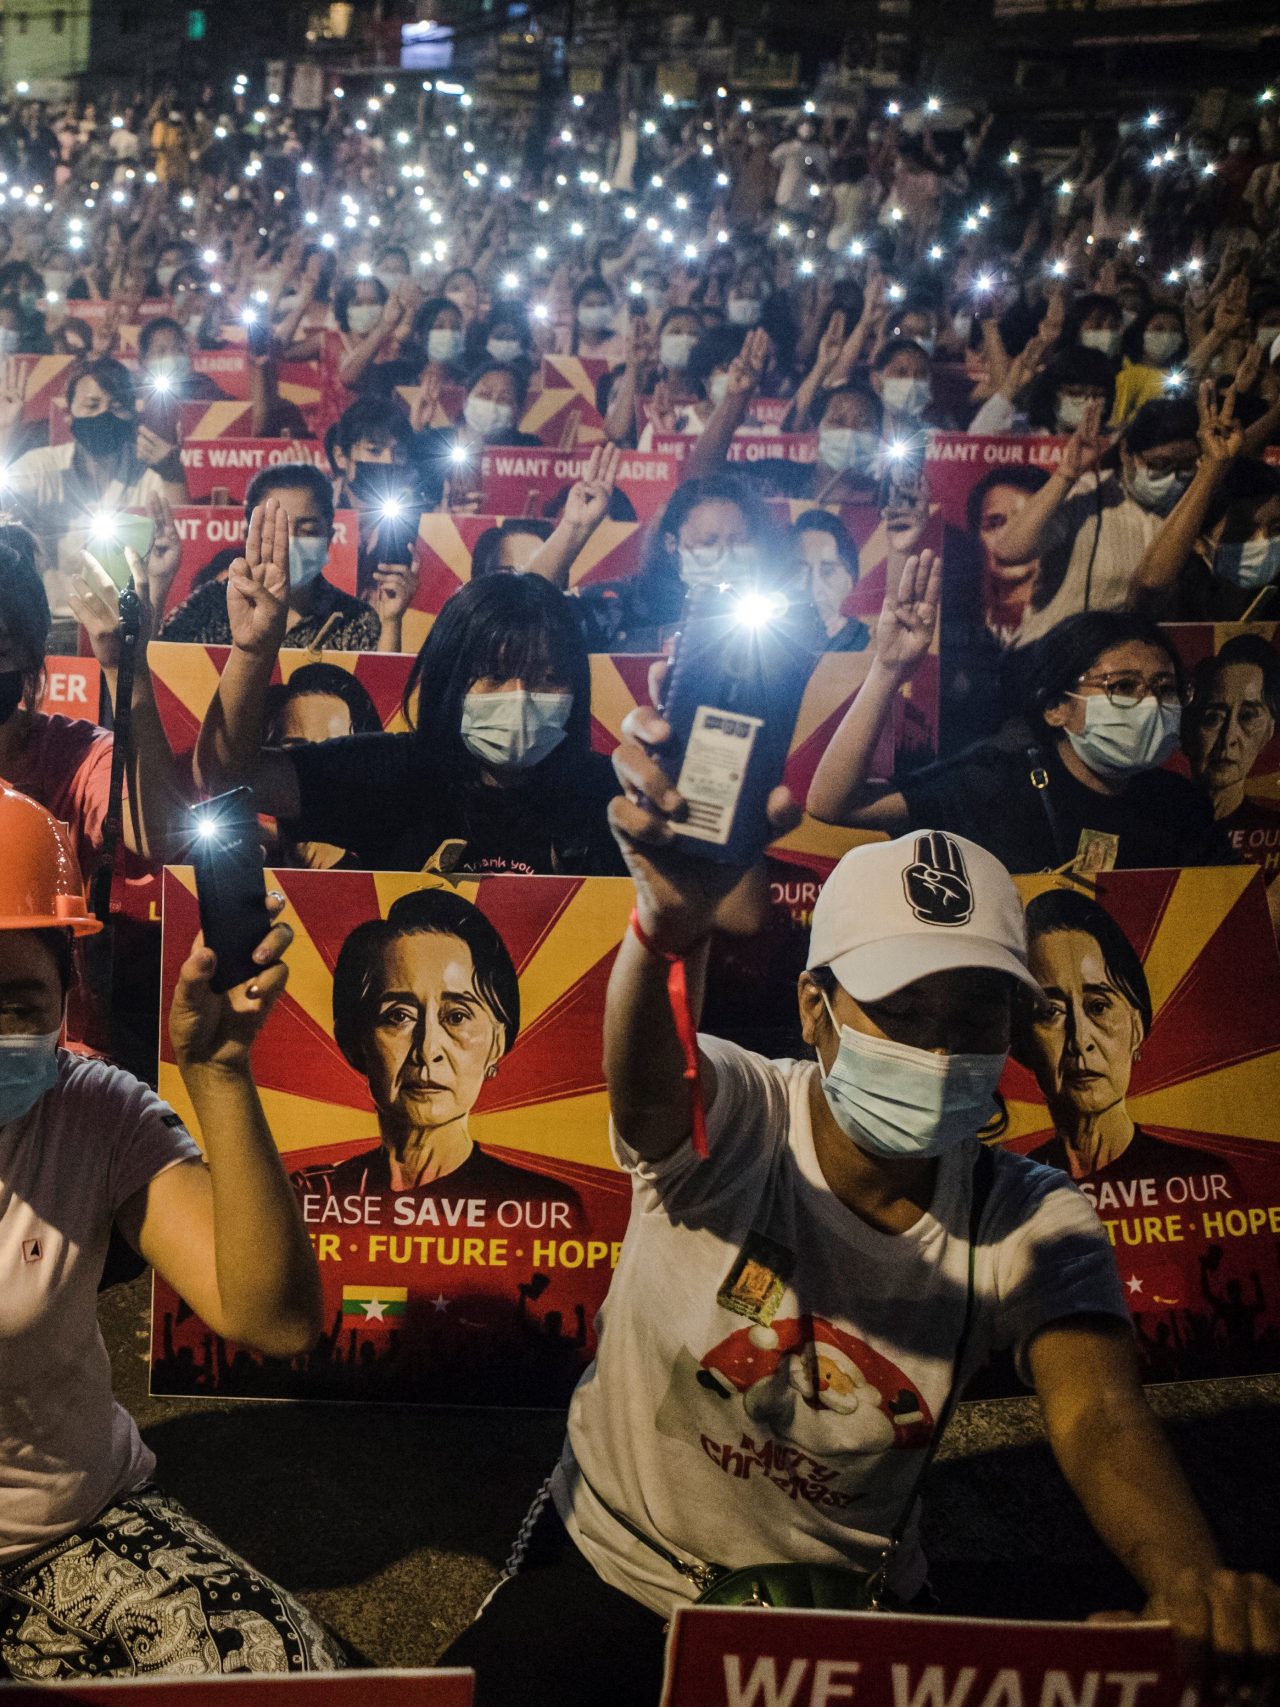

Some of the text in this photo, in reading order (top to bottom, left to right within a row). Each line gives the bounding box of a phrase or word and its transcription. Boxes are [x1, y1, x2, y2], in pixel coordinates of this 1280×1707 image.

[207, 449, 265, 469] WANT
[983, 443, 1024, 464] OUR
[495, 458, 551, 478] WANT
[619, 460, 669, 481] ADER
[1248, 828, 1280, 848] OU
[510, 859, 536, 875] you
[1078, 1173, 1233, 1211] SAVE OUR
[302, 1194, 572, 1229] EASE SAVE OUR
[1104, 1214, 1185, 1247] TURE
[368, 1233, 509, 1266] FUTURE
